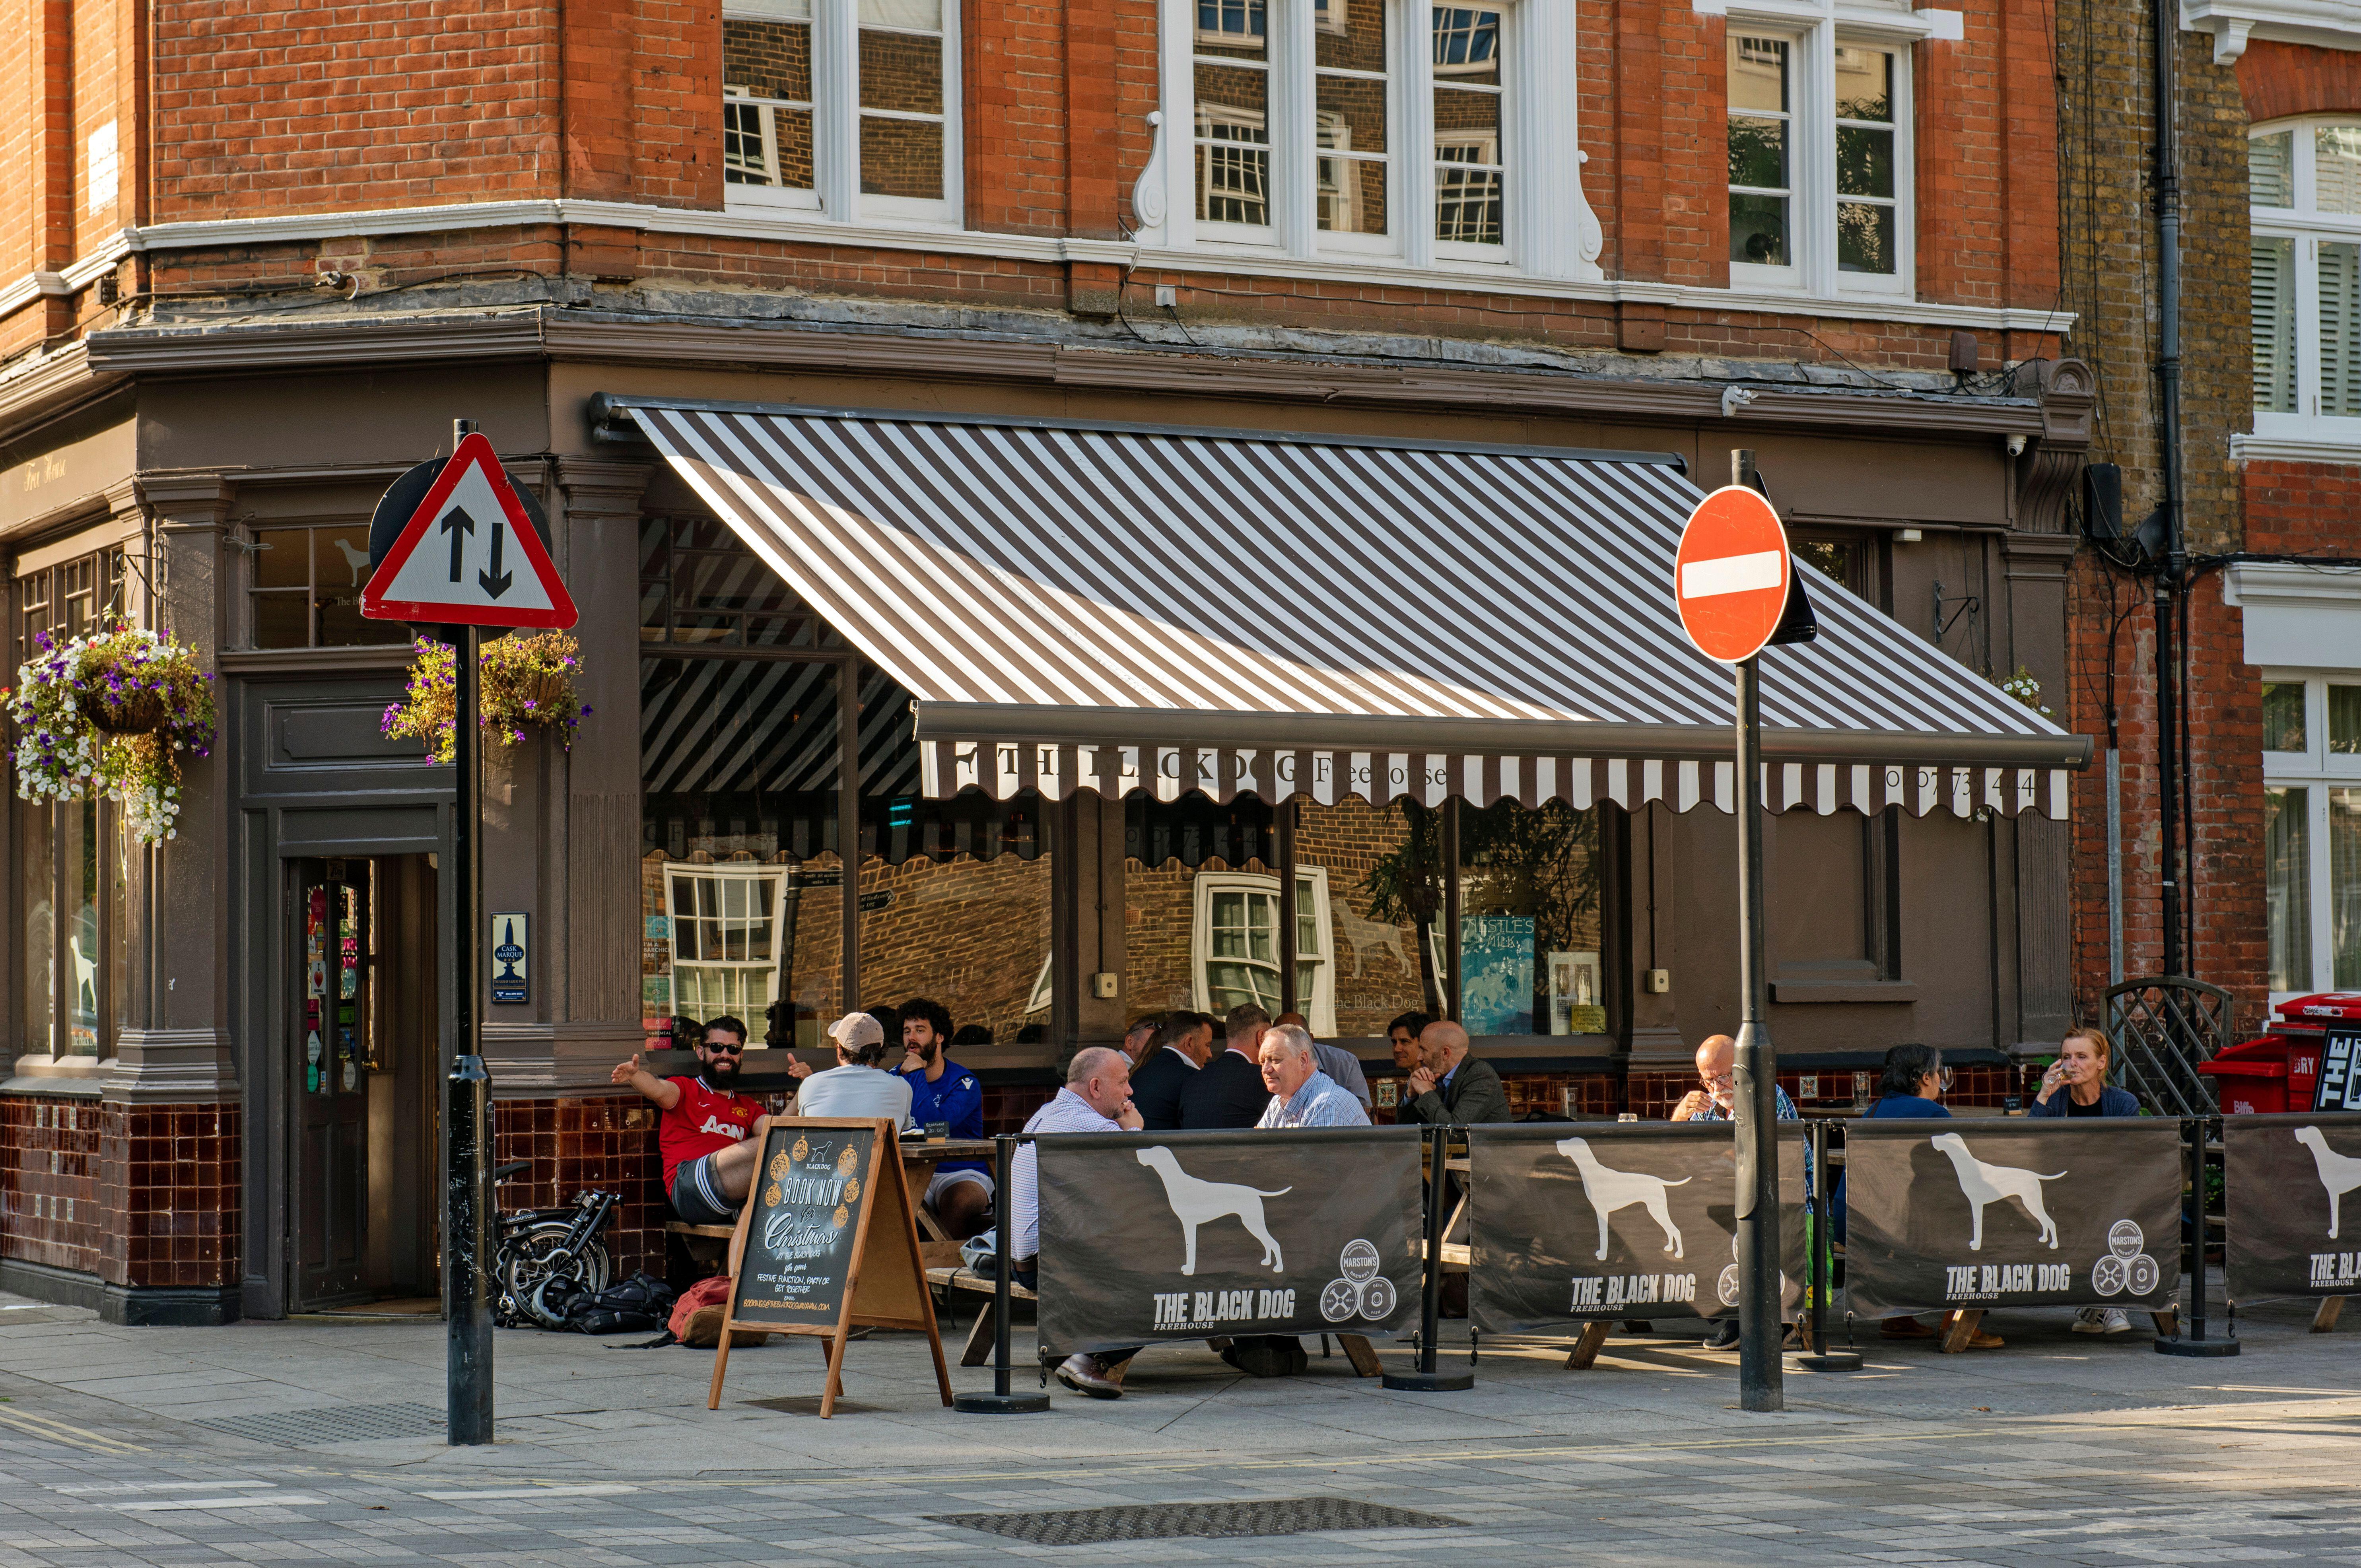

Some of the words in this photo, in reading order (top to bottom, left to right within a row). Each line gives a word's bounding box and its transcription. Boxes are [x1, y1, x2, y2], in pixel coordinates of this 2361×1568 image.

[335, 597, 351, 606] The
[997, 748, 1079, 775] TH
[1221, 754, 1296, 782] DOG
[1487, 935, 1516, 947] MILK
[1170, 994, 1208, 1006] DRINS
[1330, 994, 1351, 1008] he
[1354, 994, 1389, 1009] Black
[1392, 994, 1419, 1012] Dog
[2320, 1037, 2351, 1107] THE
[700, 1115, 744, 1141] AON
[783, 1176, 816, 1205] BOOK
[816, 1179, 843, 1207] NOW
[508, 1214, 534, 1222] BROMPTON
[801, 1206, 815, 1223] for
[764, 1212, 839, 1249] Christmas
[2111, 1235, 2141, 1245] MARSTON'S
[775, 1252, 783, 1261] AT
[785, 1251, 794, 1260] THE
[794, 1250, 810, 1259] BLACK
[810, 1249, 821, 1258] DOG
[1363, 1246, 1371, 1255] TRENT
[1343, 1256, 1377, 1267] MARSTON'S
[2310, 1253, 2336, 1280] THE
[784, 1263, 793, 1275] for
[793, 1263, 807, 1273] your
[1350, 1270, 1370, 1278] BREWERY
[757, 1273, 777, 1282] FESTIVE
[778, 1274, 806, 1285] FUNCTION,
[806, 1276, 821, 1285] PARTY
[1946, 1265, 1977, 1293] THE
[1980, 1264, 2033, 1292] BLACK
[2037, 1263, 2070, 1291] DOG
[2311, 1279, 2354, 1287] FREEHOUSE
[786, 1284, 810, 1294] TOGETHER
[1572, 1277, 1603, 1305] THE
[1606, 1274, 1660, 1305] BLACK
[1663, 1273, 1696, 1303] DOG
[1154, 1293, 1188, 1323] THE
[1193, 1290, 1254, 1321] BLACK
[1257, 1288, 1295, 1319] DOG
[1570, 1304, 1624, 1312] FREEHOUSE
[1153, 1321, 1214, 1331] FREEHOUSE
